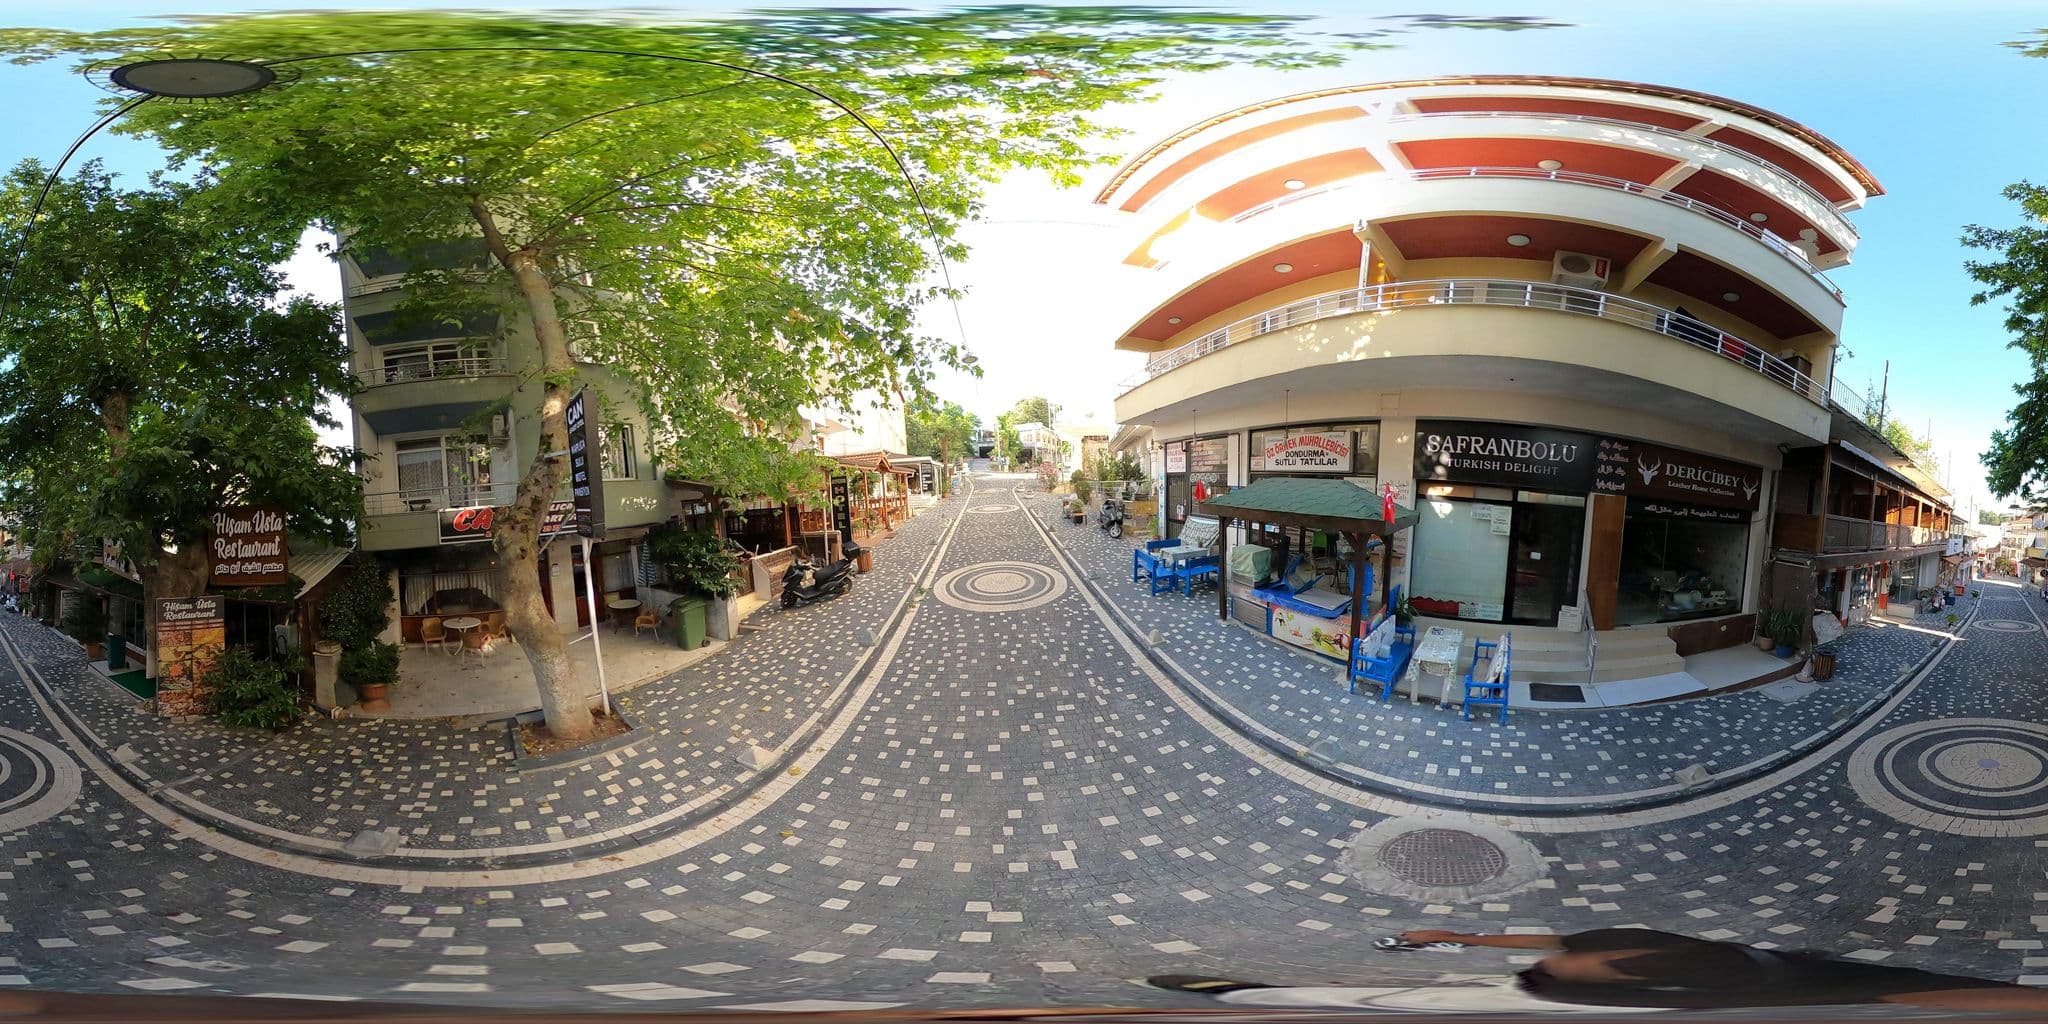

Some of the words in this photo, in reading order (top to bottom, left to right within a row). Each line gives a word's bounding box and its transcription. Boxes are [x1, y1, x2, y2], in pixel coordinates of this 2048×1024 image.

[567, 398, 584, 425] CAN
[1426, 434, 1577, 463] SAFRANBOLU
[1300, 458, 1338, 466] TATLILAR
[1447, 457, 1501, 471] TURKISH
[1504, 462, 1559, 476] DELIGHT
[1667, 480, 1691, 490] Leather
[1691, 484, 1709, 493] Home
[1709, 486, 1735, 497] Collection
[252, 510, 283, 534] Usta
[214, 535, 281, 559] Restaurant
[195, 599, 216, 609] Usta
[163, 609, 216, 620] Restaurant
